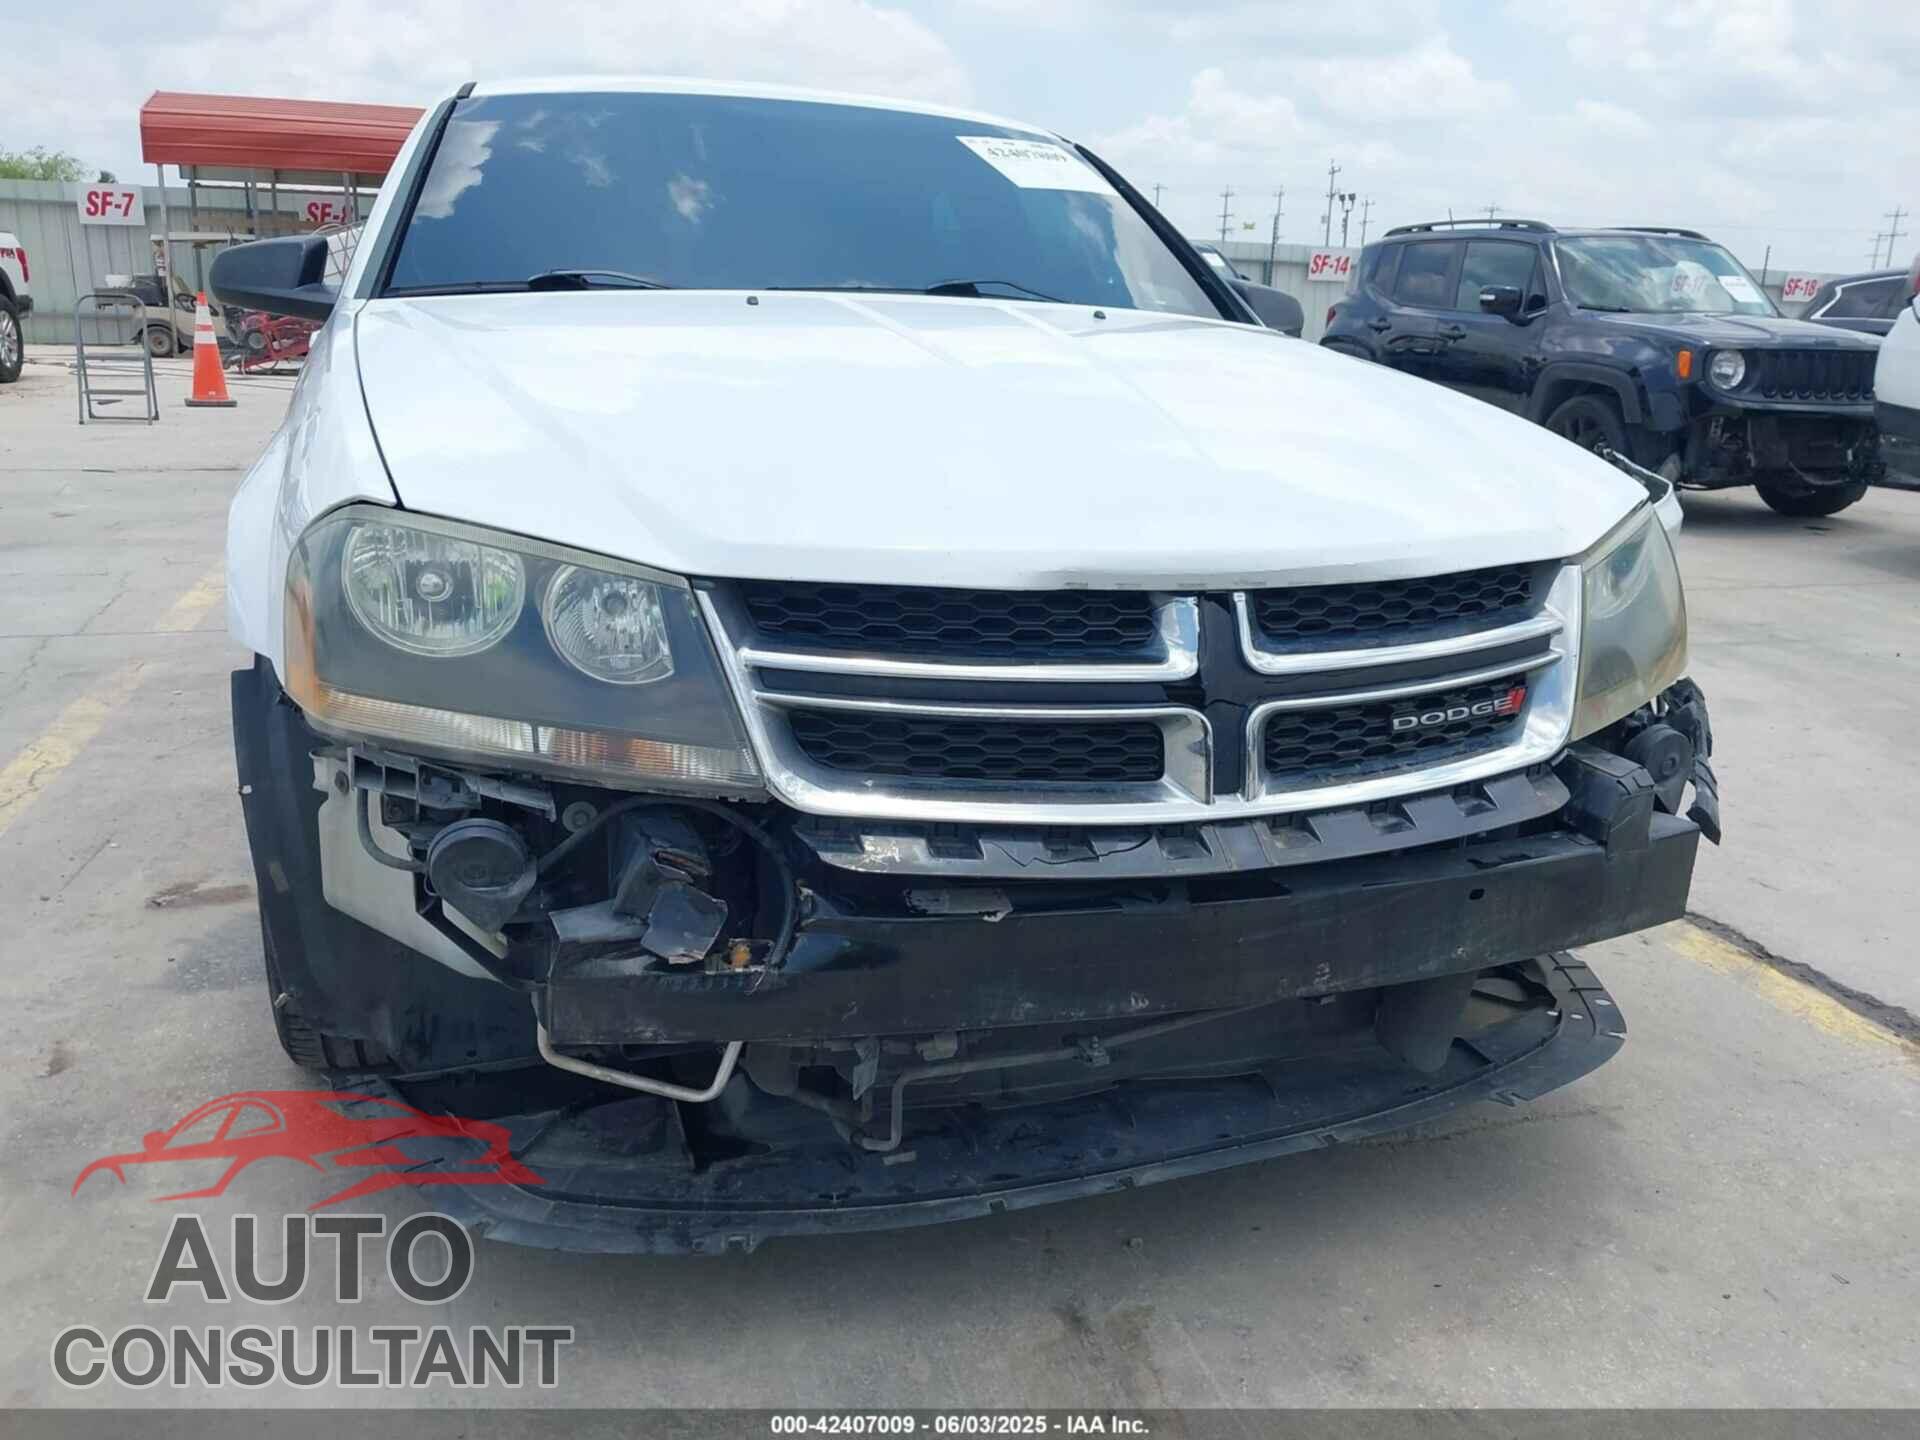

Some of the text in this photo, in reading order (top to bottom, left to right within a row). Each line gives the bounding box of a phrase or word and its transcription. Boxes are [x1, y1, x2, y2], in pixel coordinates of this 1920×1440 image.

[86, 190, 135, 217] SF-7
[1311, 254, 1350, 275] SF-14
[1785, 278, 1817, 297] SF-18
[1392, 696, 1513, 730] DODGE
